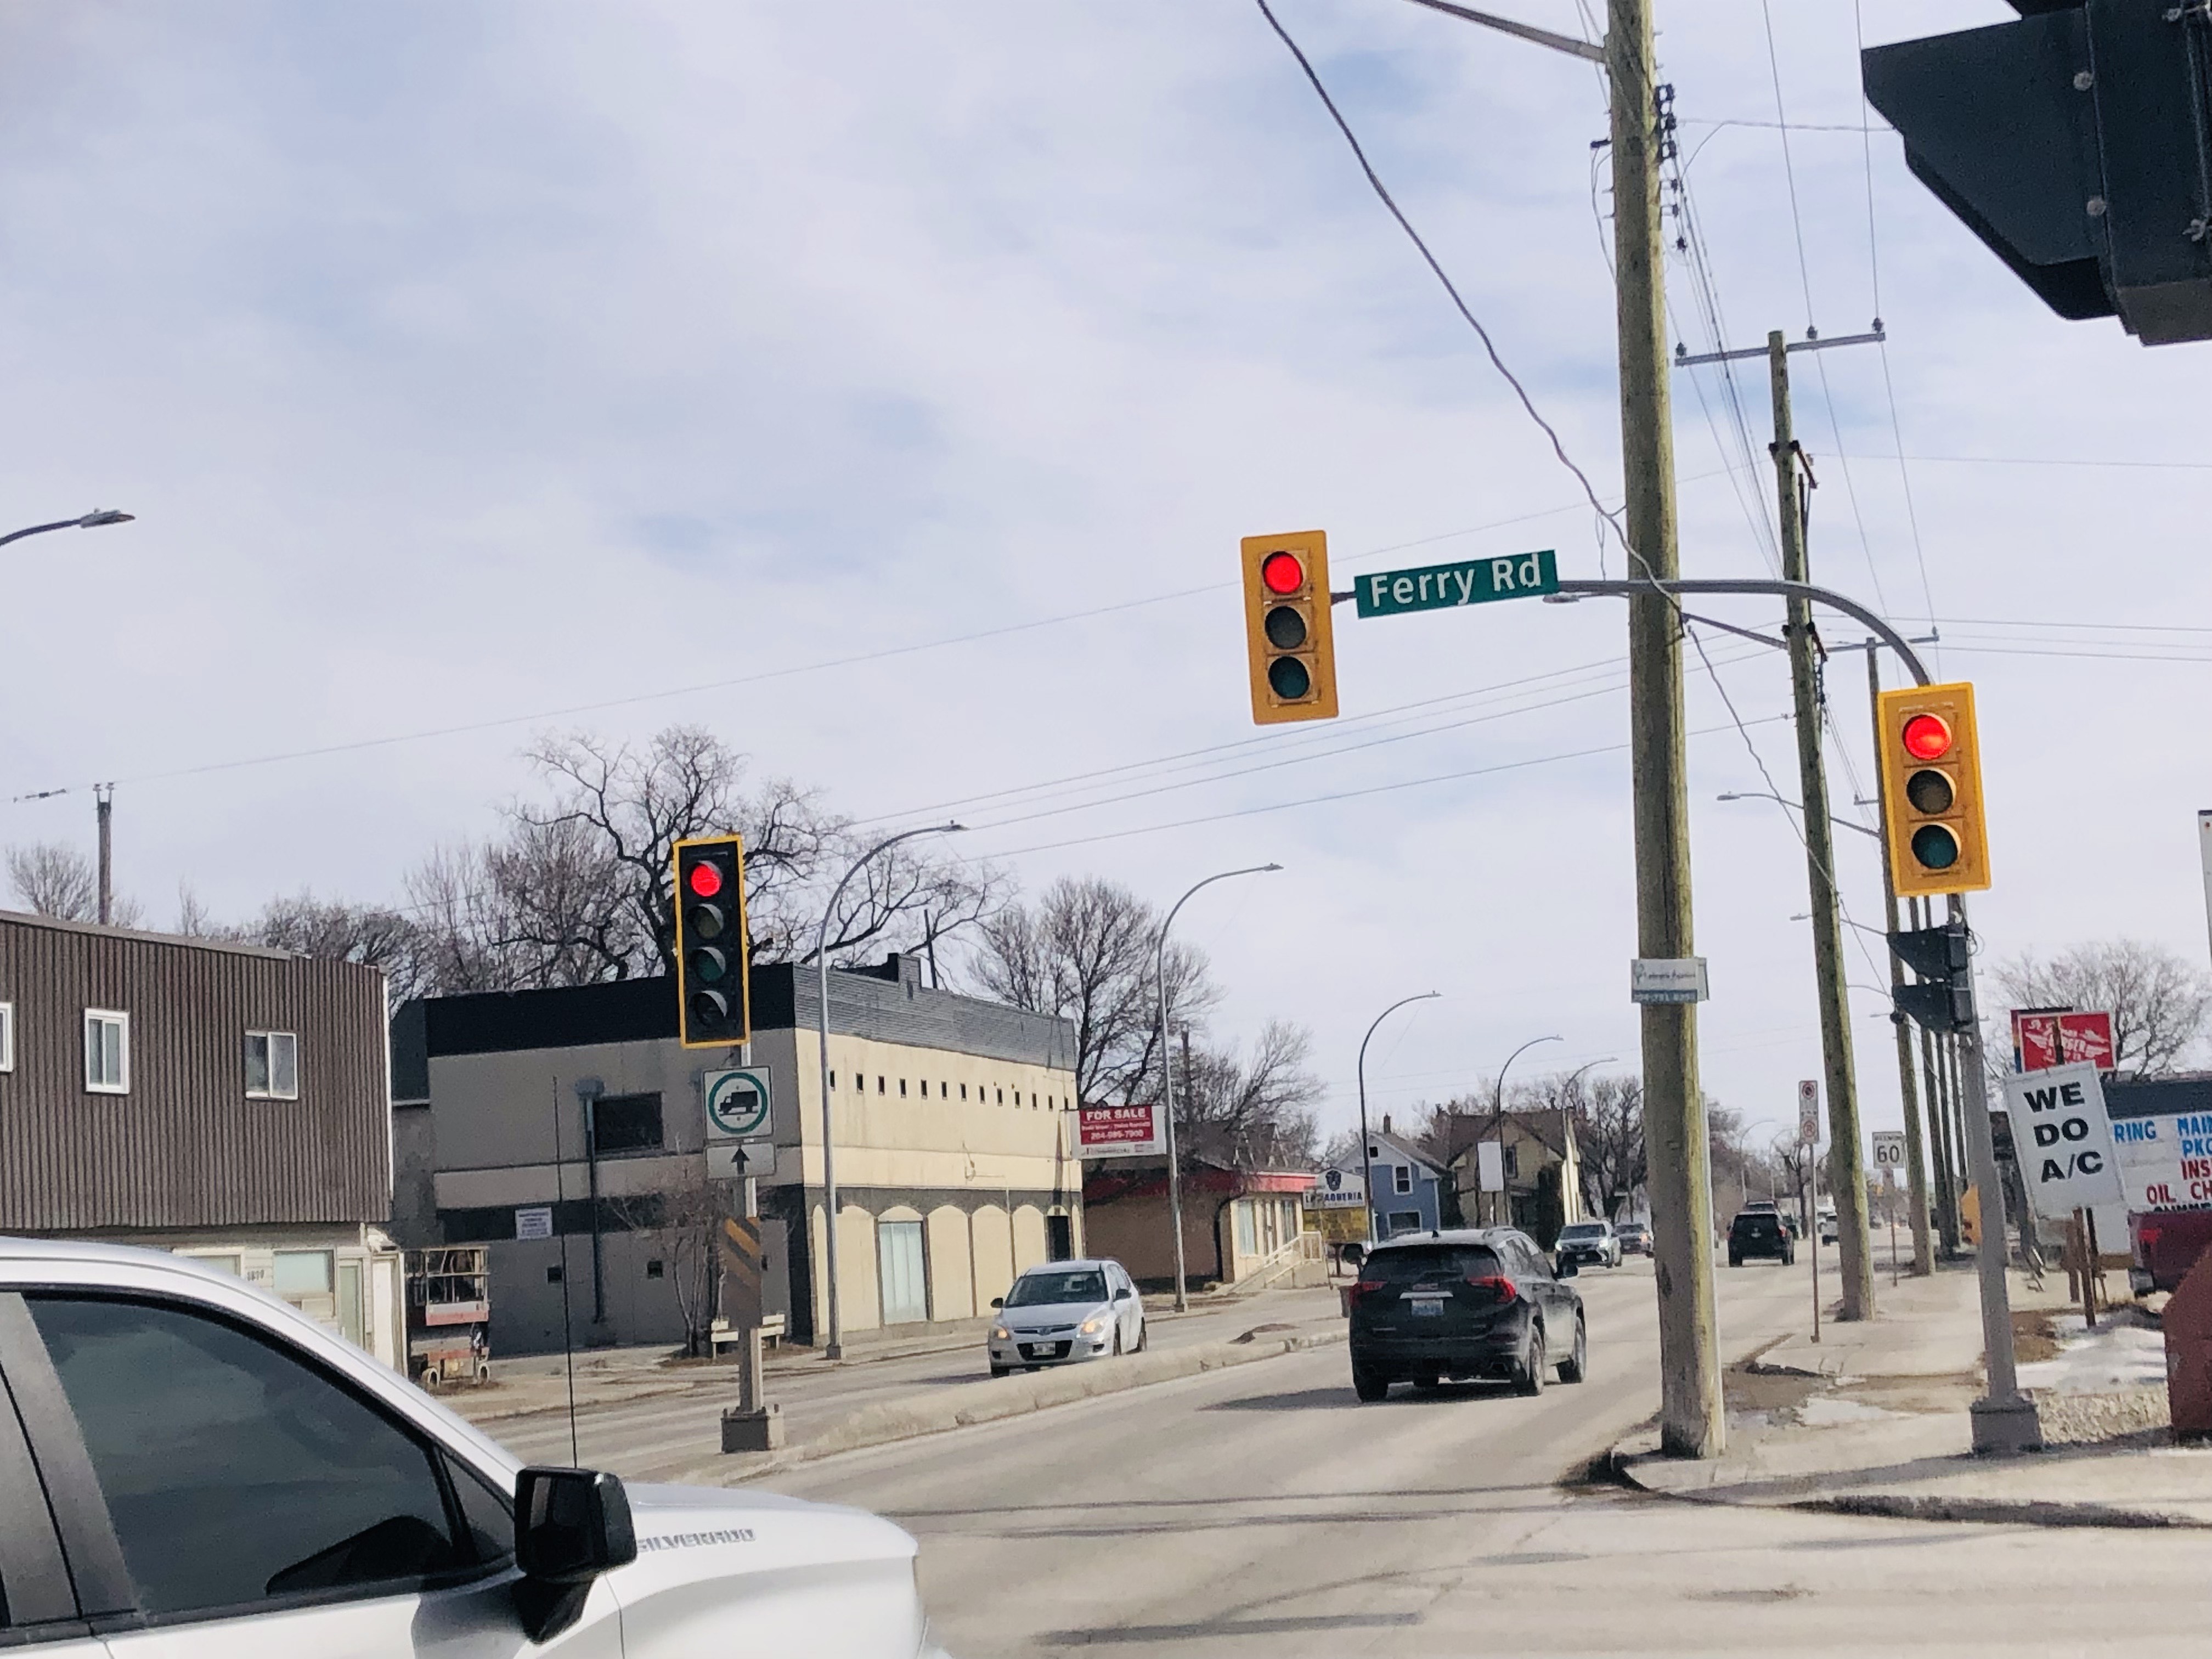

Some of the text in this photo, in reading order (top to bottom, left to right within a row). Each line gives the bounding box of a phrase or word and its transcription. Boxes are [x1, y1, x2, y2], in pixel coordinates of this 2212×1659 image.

[1371, 552, 1541, 607] Ferry Rd
[2023, 1081, 2085, 1113] WE
[1086, 1108, 1146, 1121] FOR SALE
[2033, 1118, 2089, 1147] DO
[1877, 1145, 1899, 1163] 60
[2041, 1151, 2103, 1183] A/C
[2146, 1184, 2176, 1205] OIL
[637, 1528, 757, 1553] SILVERADO
